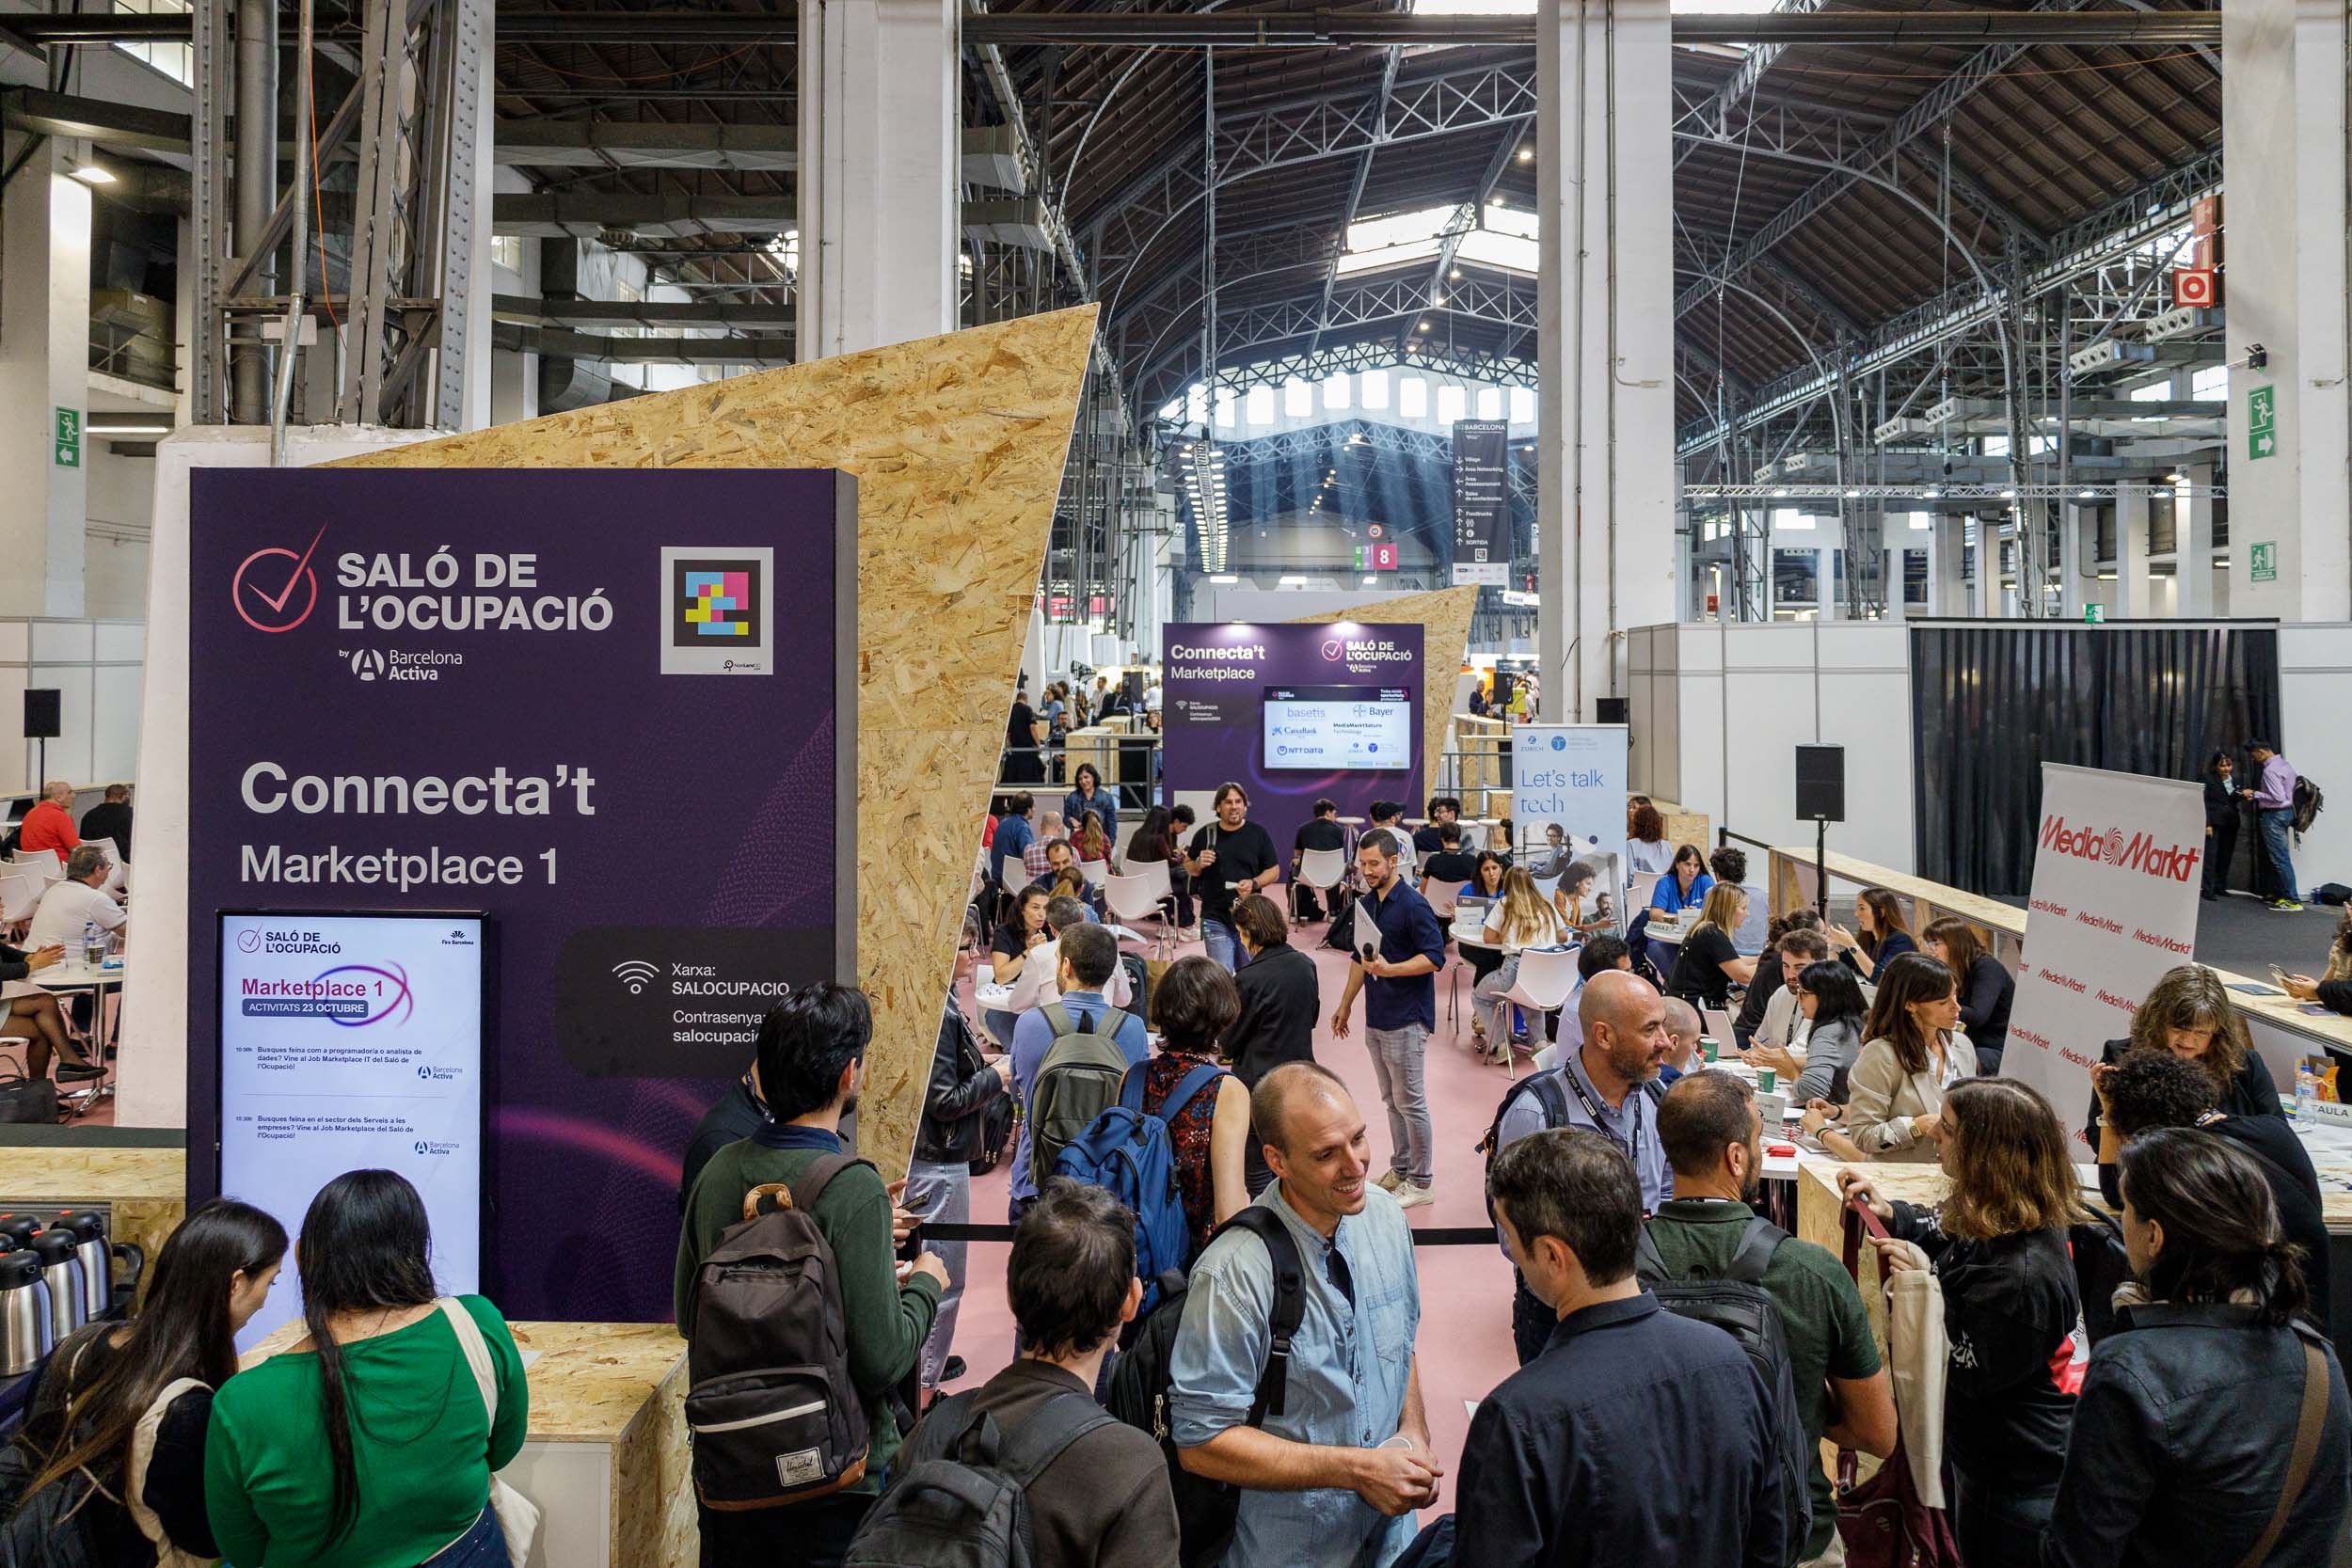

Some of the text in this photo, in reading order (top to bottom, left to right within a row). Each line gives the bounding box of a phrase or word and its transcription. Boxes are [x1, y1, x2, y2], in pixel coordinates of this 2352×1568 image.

[1380, 549, 1389, 564] 8
[338, 545, 537, 588] SALÓ DE
[338, 588, 613, 631] L'OCUPACIÓ
[339, 649, 349, 657] by
[1170, 644, 1265, 659] Connecta't
[1345, 640, 1394, 651] SALÓ DE
[389, 649, 463, 665] Barcelona
[389, 665, 438, 680] Activa
[1170, 666, 1256, 682] Marketplace
[1369, 706, 1393, 718] Bayer
[1521, 769, 1603, 787] Let's talk
[240, 761, 595, 816] Connecta't
[1520, 793, 1565, 813] tech
[241, 845, 557, 892] Marketplace 1
[265, 929, 321, 942] SALÓ DE
[672, 962, 716, 976] Xarxa:
[242, 978, 383, 1001] Marketplace 1
[672, 981, 789, 996] SALOCUPACIO
[248, 1003, 365, 1014] ACTIVITATS 23 OCTUBRE
[257, 1046, 287, 1054] Busques
